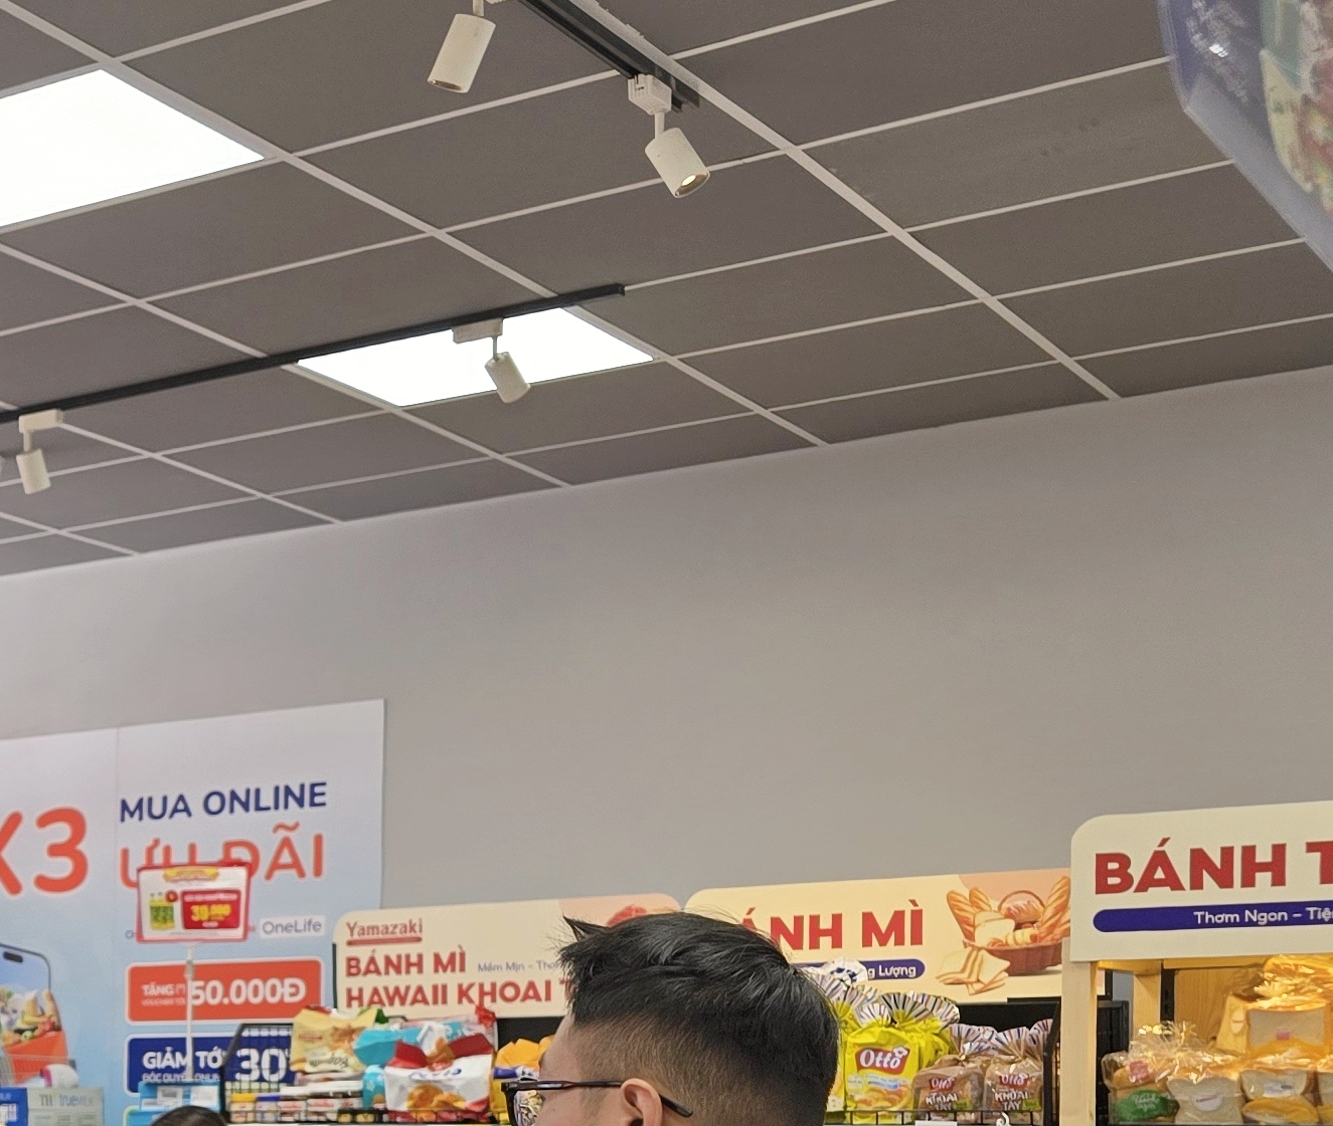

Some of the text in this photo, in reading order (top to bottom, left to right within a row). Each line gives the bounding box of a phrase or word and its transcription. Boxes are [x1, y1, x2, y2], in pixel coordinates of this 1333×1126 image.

[119, 781, 328, 823] MUA ONLINE
[1094, 836, 1288, 896] BÁNH
[262, 917, 323, 936] OneLife
[346, 917, 424, 937] Yamazaki
[861, 899, 924, 949] MÌ
[1193, 908, 1289, 927] Thơm Ngon
[345, 948, 424, 978] BÁNH
[433, 944, 467, 975] MÌ
[878, 963, 917, 978] Lượng
[345, 978, 553, 1009] HAWAII KHOAI
[142, 1046, 188, 1070] GIẢM
[858, 1046, 905, 1070] Otto
[1000, 1072, 1029, 1086] Otto
